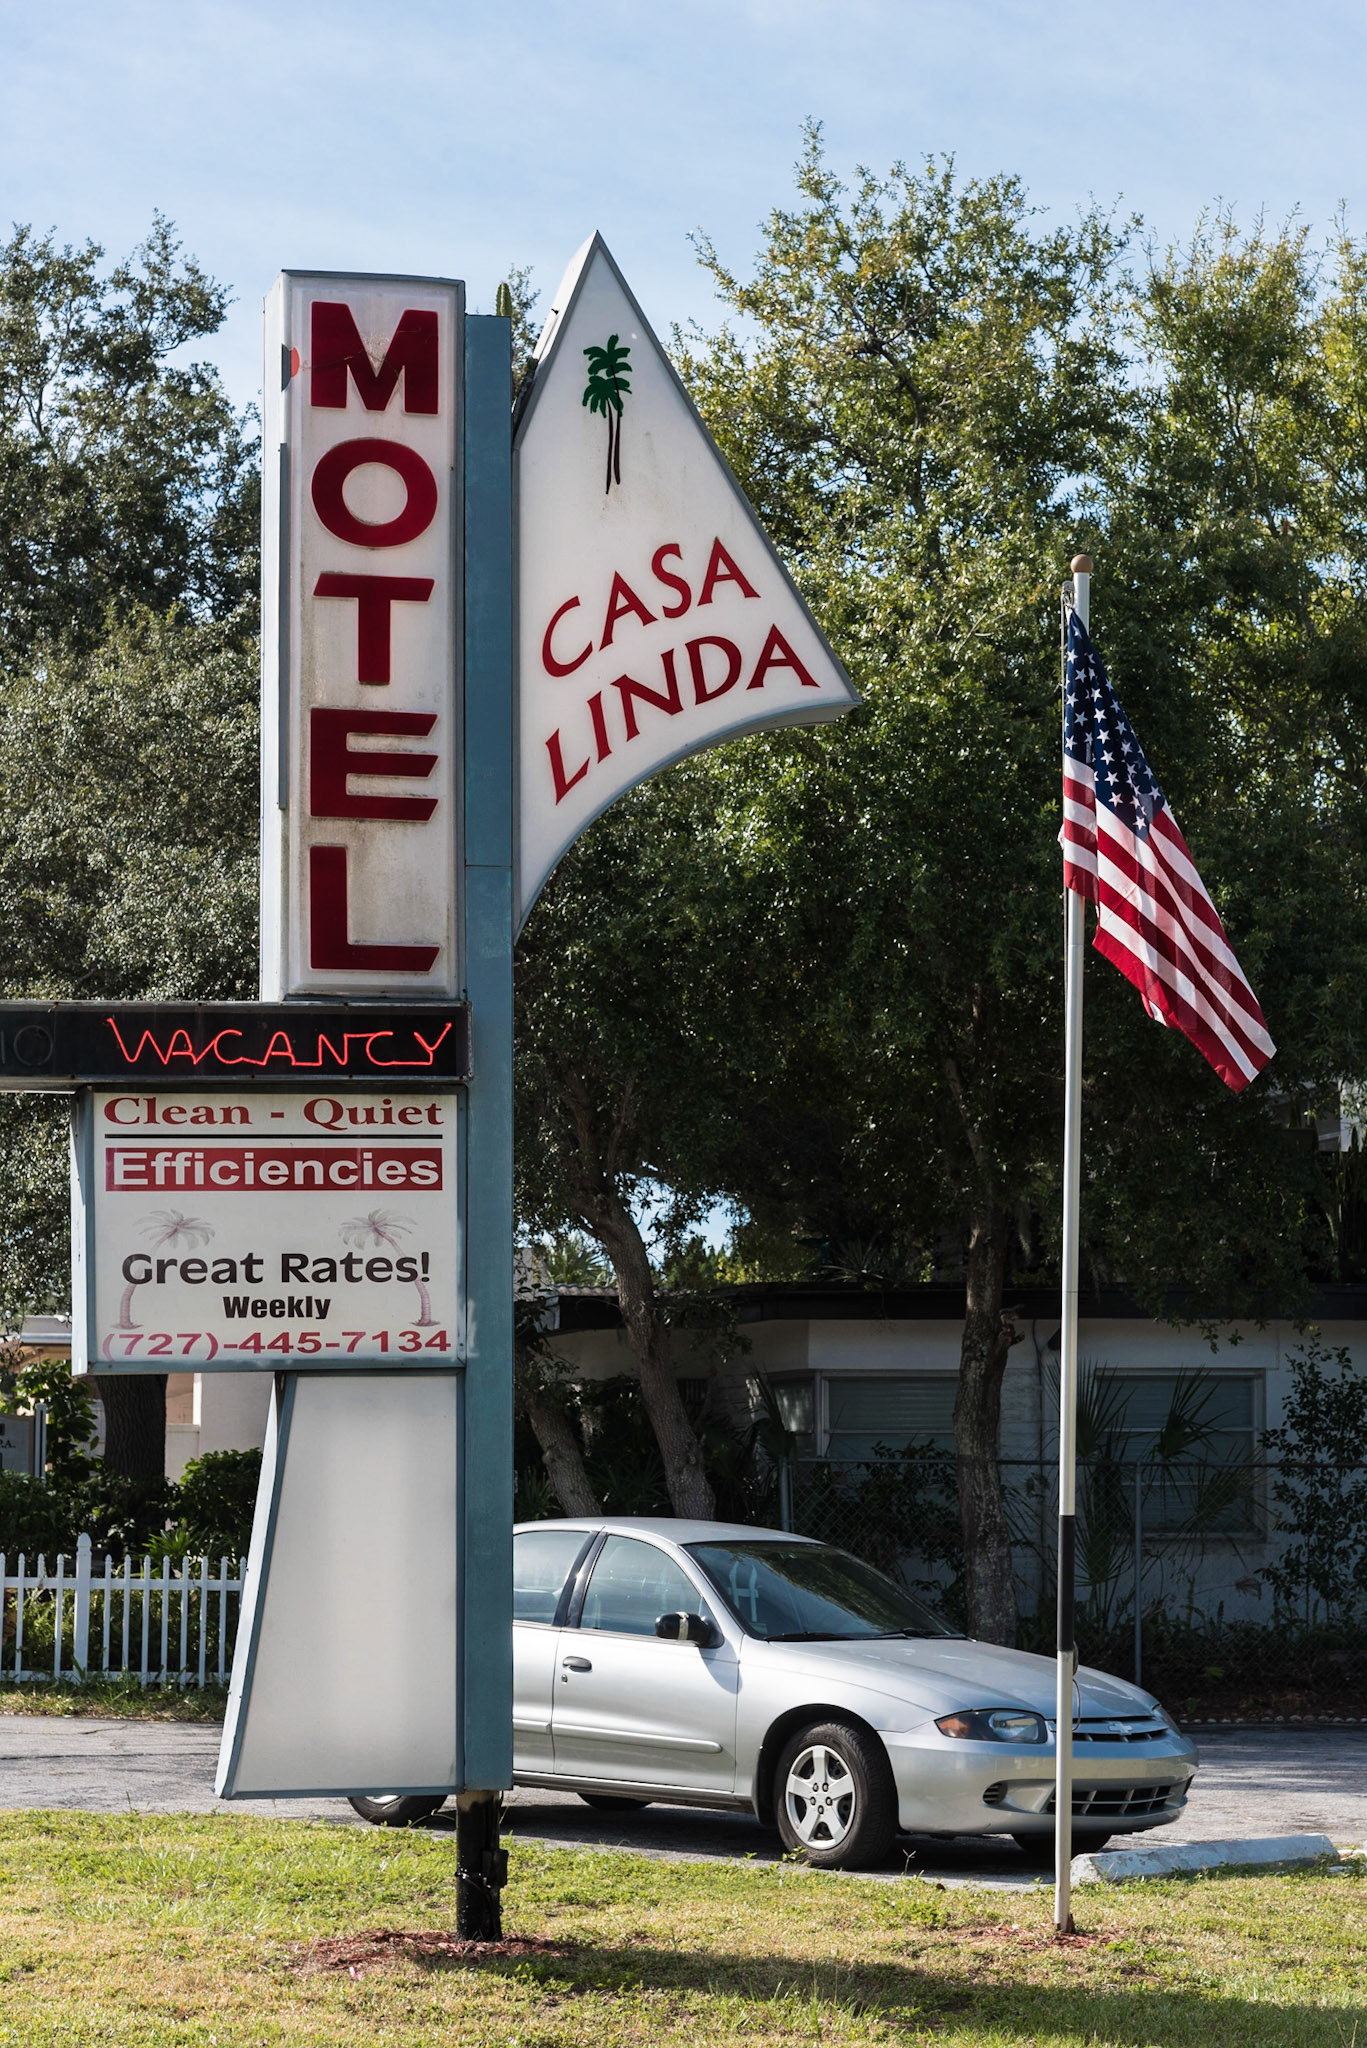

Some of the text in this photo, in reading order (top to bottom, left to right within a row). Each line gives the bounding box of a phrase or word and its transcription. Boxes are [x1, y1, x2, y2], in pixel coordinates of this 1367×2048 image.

[541, 537, 761, 678] CASA
[309, 300, 440, 971] MOTEL
[545, 623, 820, 805] LINDA
[0, 1017, 452, 1066] O VACANCY
[103, 1097, 252, 1126] Clean
[303, 1098, 444, 1131] Quiet
[113, 1151, 439, 1185] Efficiencies
[122, 1251, 430, 1284] Great Rates!
[223, 1296, 331, 1320] Weekly
[102, 1329, 451, 1361] (727)-445-7134
